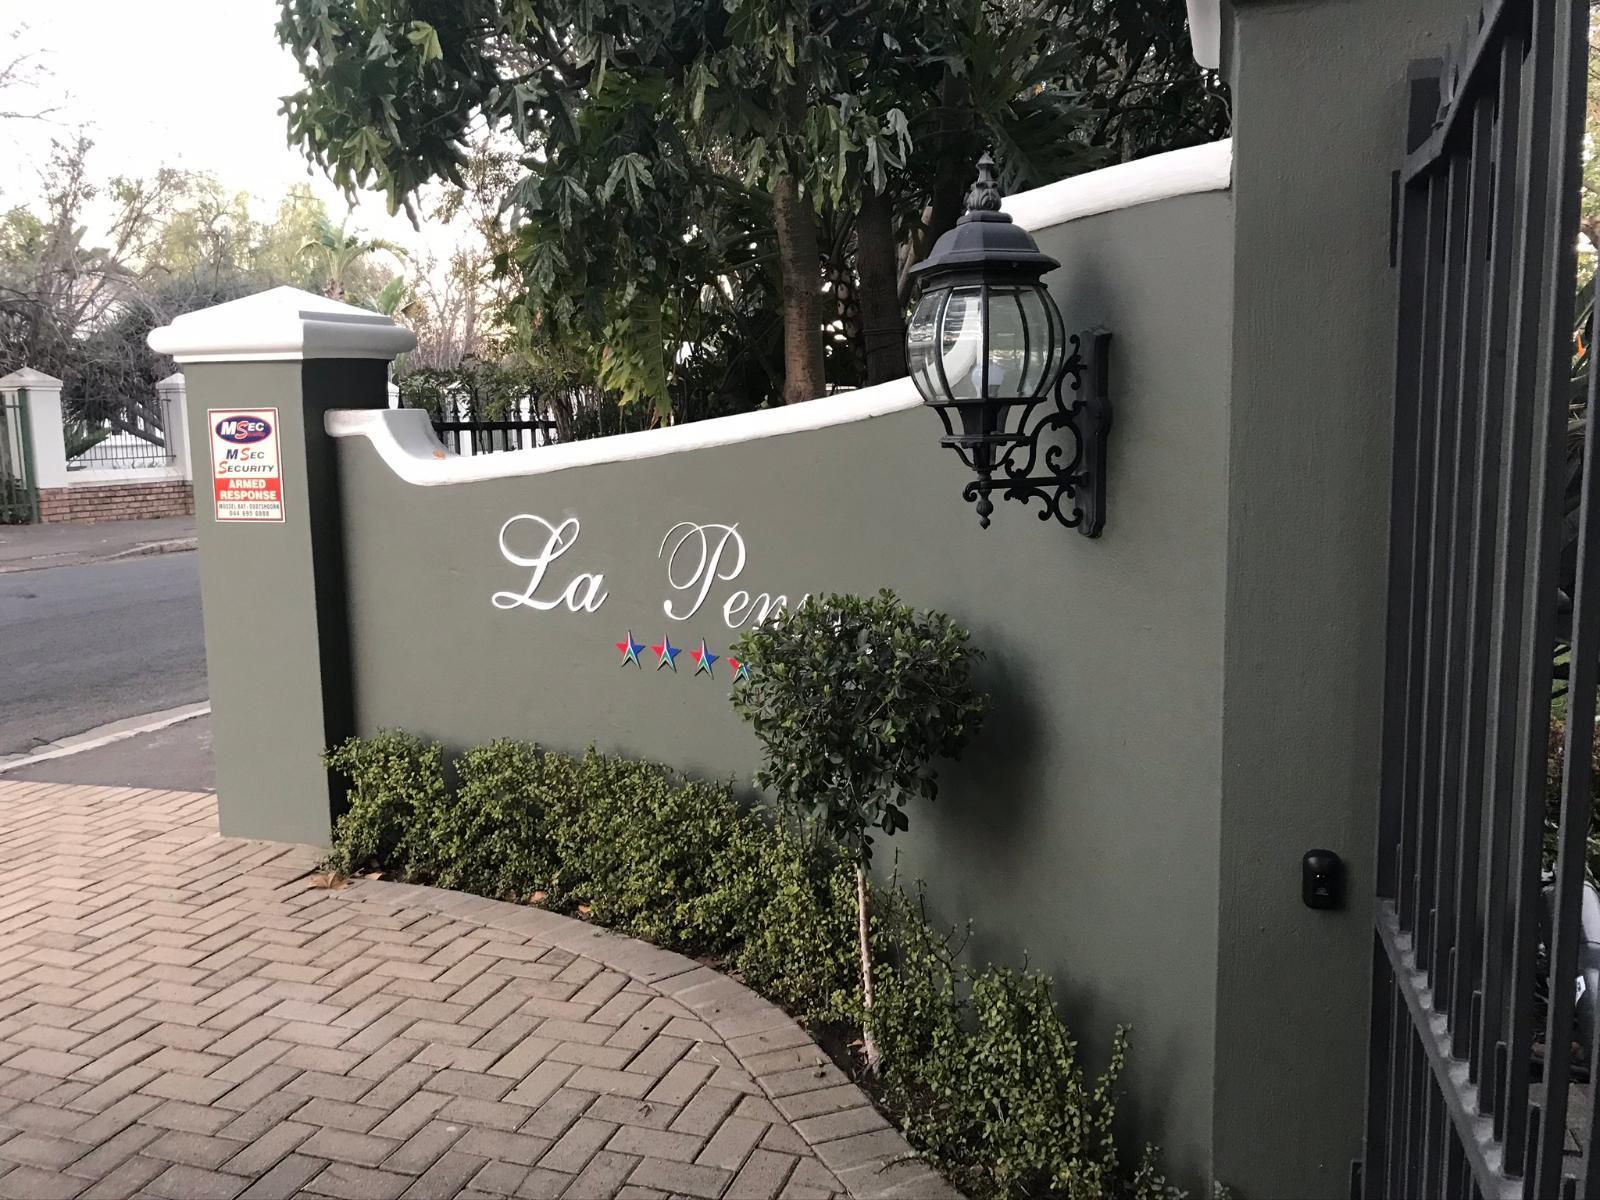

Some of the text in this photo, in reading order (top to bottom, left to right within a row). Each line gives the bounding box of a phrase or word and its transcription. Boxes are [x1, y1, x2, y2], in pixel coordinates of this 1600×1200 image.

[218, 461, 273, 474] SECURITY
[229, 479, 266, 489] ARMED
[220, 490, 277, 500] RESPONSE
[491, 513, 609, 613] La
